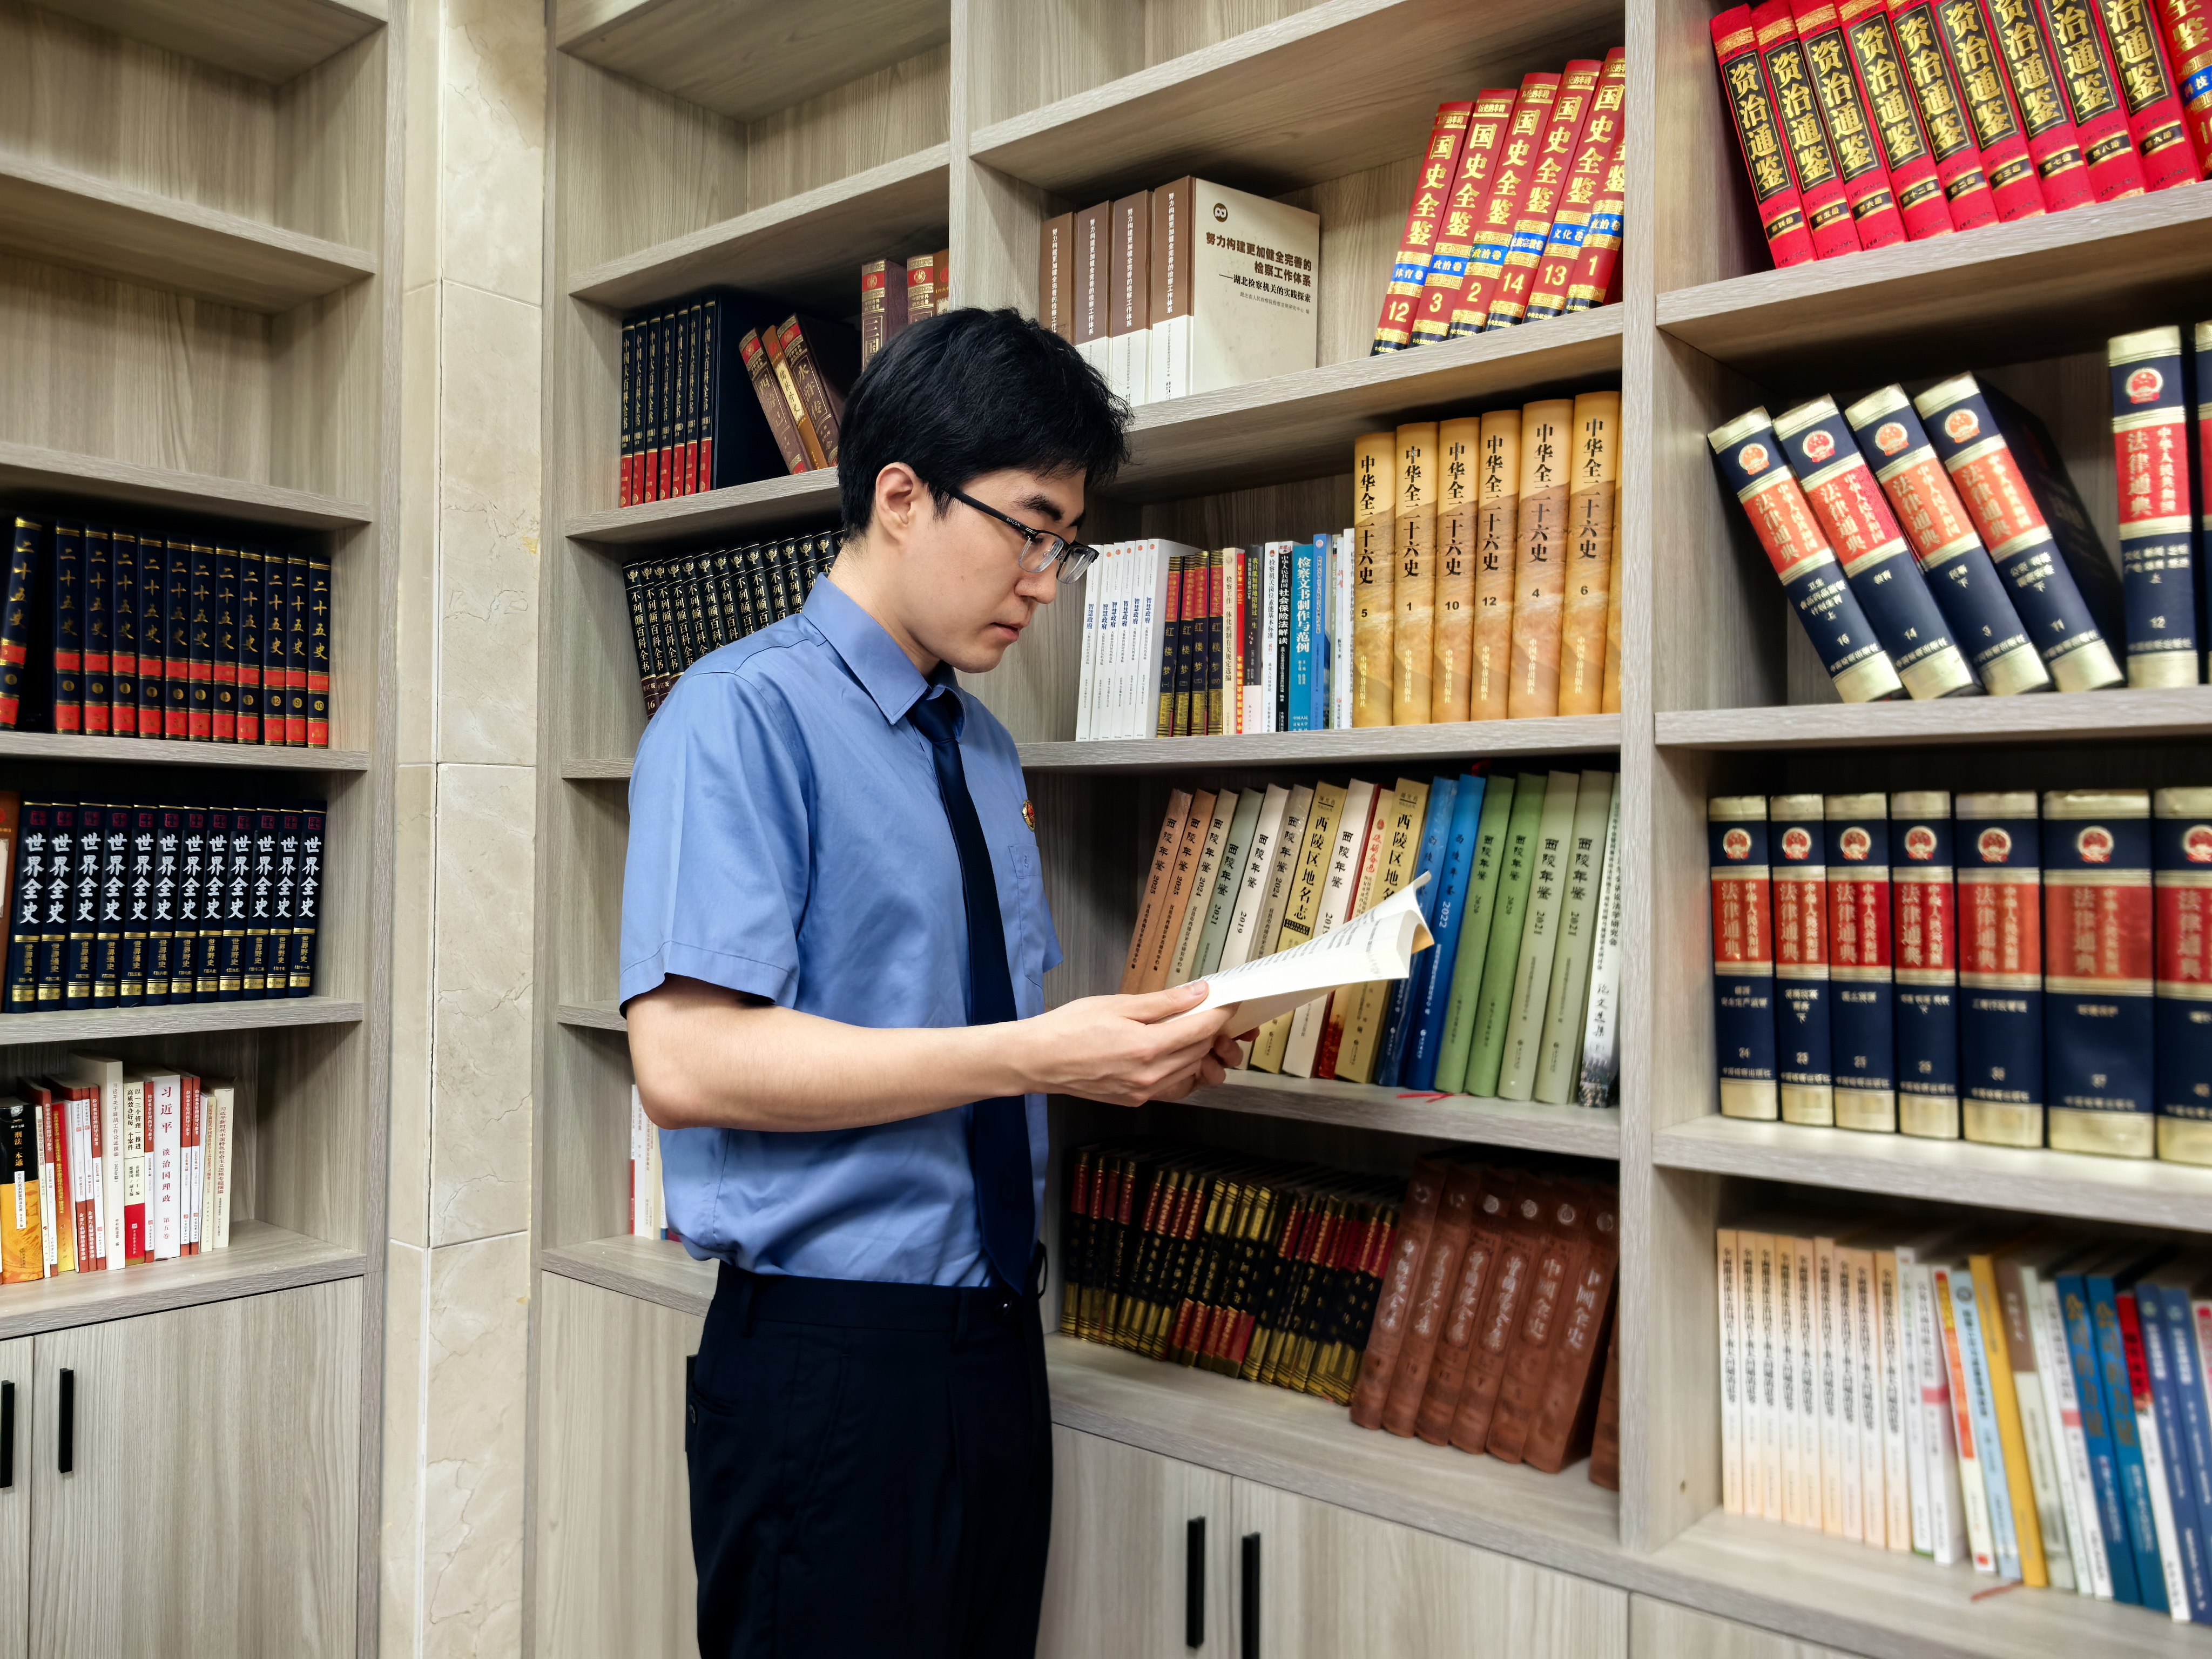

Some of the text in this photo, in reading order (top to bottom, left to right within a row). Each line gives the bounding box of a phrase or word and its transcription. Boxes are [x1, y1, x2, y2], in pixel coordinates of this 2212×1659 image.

[1856, 26, 1920, 161] 资治通鉴
[1900, 16, 1965, 159] 资治通鉴
[1945, 2, 2012, 140] 资治通鉴
[1993, 0, 2059, 130] 资治通鉴
[1729, 61, 1785, 198] 资治通鉴
[1772, 50, 1831, 185] 资治通鉴
[1811, 39, 1873, 174] 资治通鉴
[1485, 109, 1541, 225] 国史全鉴
[1526, 96, 1582, 213] 国史全鉴
[1567, 84, 1625, 204] 国史全鉴
[1406, 134, 1456, 246] 国史全鉴
[1445, 123, 1498, 237] 国史全鉴
[1206, 232, 1312, 272] 努力构建更加健全完善的
[1472, 247, 1502, 260] 政治卷
[1553, 228, 1583, 242] 文化卷
[1590, 219, 1621, 232] 政治卷
[1254, 261, 1311, 287] 检察工作体系
[1395, 268, 1424, 280] 体育卷
[1433, 260, 1462, 272] 政治卷
[1467, 282, 1481, 302] 2
[1503, 273, 1525, 294] 14
[1545, 265, 1567, 286] 13
[1588, 255, 1599, 276] 1
[1389, 301, 1410, 322] 12
[1429, 293, 1443, 312] 3
[779, 370, 800, 416] 儒林外史
[798, 363, 822, 419] 水浒传
[1482, 435, 1503, 572] 中华全二十六史
[1529, 423, 1553, 563] 中华全二十六史
[1579, 417, 1603, 559] 中华全二十六史
[2128, 430, 2152, 518] 法律通典
[1359, 455, 1375, 585] 中华全二十六史
[1403, 446, 1421, 578] 中华全二十六史
[1445, 442, 1465, 576] 中华全二十六史
[1820, 482, 1867, 556] 法律通典
[10, 541, 34, 629] 二十五史
[60, 548, 77, 636] 二十五史
[90, 550, 107, 638] 二十五史
[117, 553, 133, 639] 二十五史
[144, 558, 161, 644] 二十五史
[171, 561, 187, 646] 二十五史
[194, 564, 210, 649] 二十五史
[219, 567, 235, 650] 二十五史
[242, 570, 259, 653] 二十五史
[268, 575, 284, 656] 二十五史
[291, 576, 306, 657] 二十五史
[1086, 603, 1094, 629] 智慧政府
[1296, 557, 1311, 652] 检察文书制作与范例
[1361, 609, 1367, 618] 5
[1406, 603, 1412, 611] 1
[1445, 601, 1459, 611] 10
[1482, 597, 1496, 606] 12
[1532, 589, 1540, 598] 4
[1580, 586, 1588, 595] 6
[313, 580, 328, 660] 二十五史
[631, 591, 650, 673] 不列颠百科全书
[646, 588, 664, 671] 不列颠百科全书
[659, 586, 678, 670] 不列颠百科全书
[673, 586, 693, 668] 不列颠百科全书
[204, 834, 227, 919] 世界全史
[228, 834, 252, 919] 世界全史
[252, 834, 275, 918] 世界全史
[275, 835, 299, 918] 世界全史
[299, 835, 322, 918] 世界全史
[1155, 818, 1177, 872] 西陵年鉴
[1179, 818, 1201, 872] 西陵年鉴
[1202, 819, 1223, 873] 西陵年鉴
[1218, 844, 1239, 896] 西陵年鉴
[1247, 834, 1269, 889] 西陵年鉴
[1277, 816, 1299, 873] 西陵年鉴
[1294, 816, 1330, 921] 西陵区地名志
[1332, 831, 1353, 889] 西陵年鉴
[1477, 835, 1494, 881] 西陵年鉴
[1509, 835, 1527, 881] 西陵年鉴
[1537, 838, 1559, 901] 西陵年鉴
[1570, 837, 1593, 901] 西陵年鉴
[20, 832, 46, 924] 世界全史
[46, 833, 73, 924] 世界全史
[77, 833, 101, 922] 世界全史
[103, 833, 127, 922] 世界全史
[130, 833, 154, 921] 世界全史
[154, 834, 179, 921] 世界全史
[179, 834, 204, 920] 世界全史
[1150, 875, 1159, 895] 2025
[1173, 875, 1183, 895] 2025
[1196, 878, 1205, 897] 2024
[1272, 877, 1282, 898] 2024
[1211, 904, 1221, 925] 2021
[1237, 910, 1246, 934] 2019
[1439, 901, 1451, 928] 2022
[1534, 910, 1545, 936] 2021
[1568, 911, 1580, 936] 2021
[182, 939, 191, 967] 世界野史
[207, 939, 215, 966] 世界野史
[231, 938, 240, 966] 世界野史
[254, 937, 263, 964] 世界野史
[278, 936, 286, 963] 世界野史
[300, 936, 309, 962] 世界野史
[160, 1086, 173, 1134] 习近平
[15, 1131, 23, 1166] 刑法一本通
[161, 1148, 171, 1203] 谈治国理政
